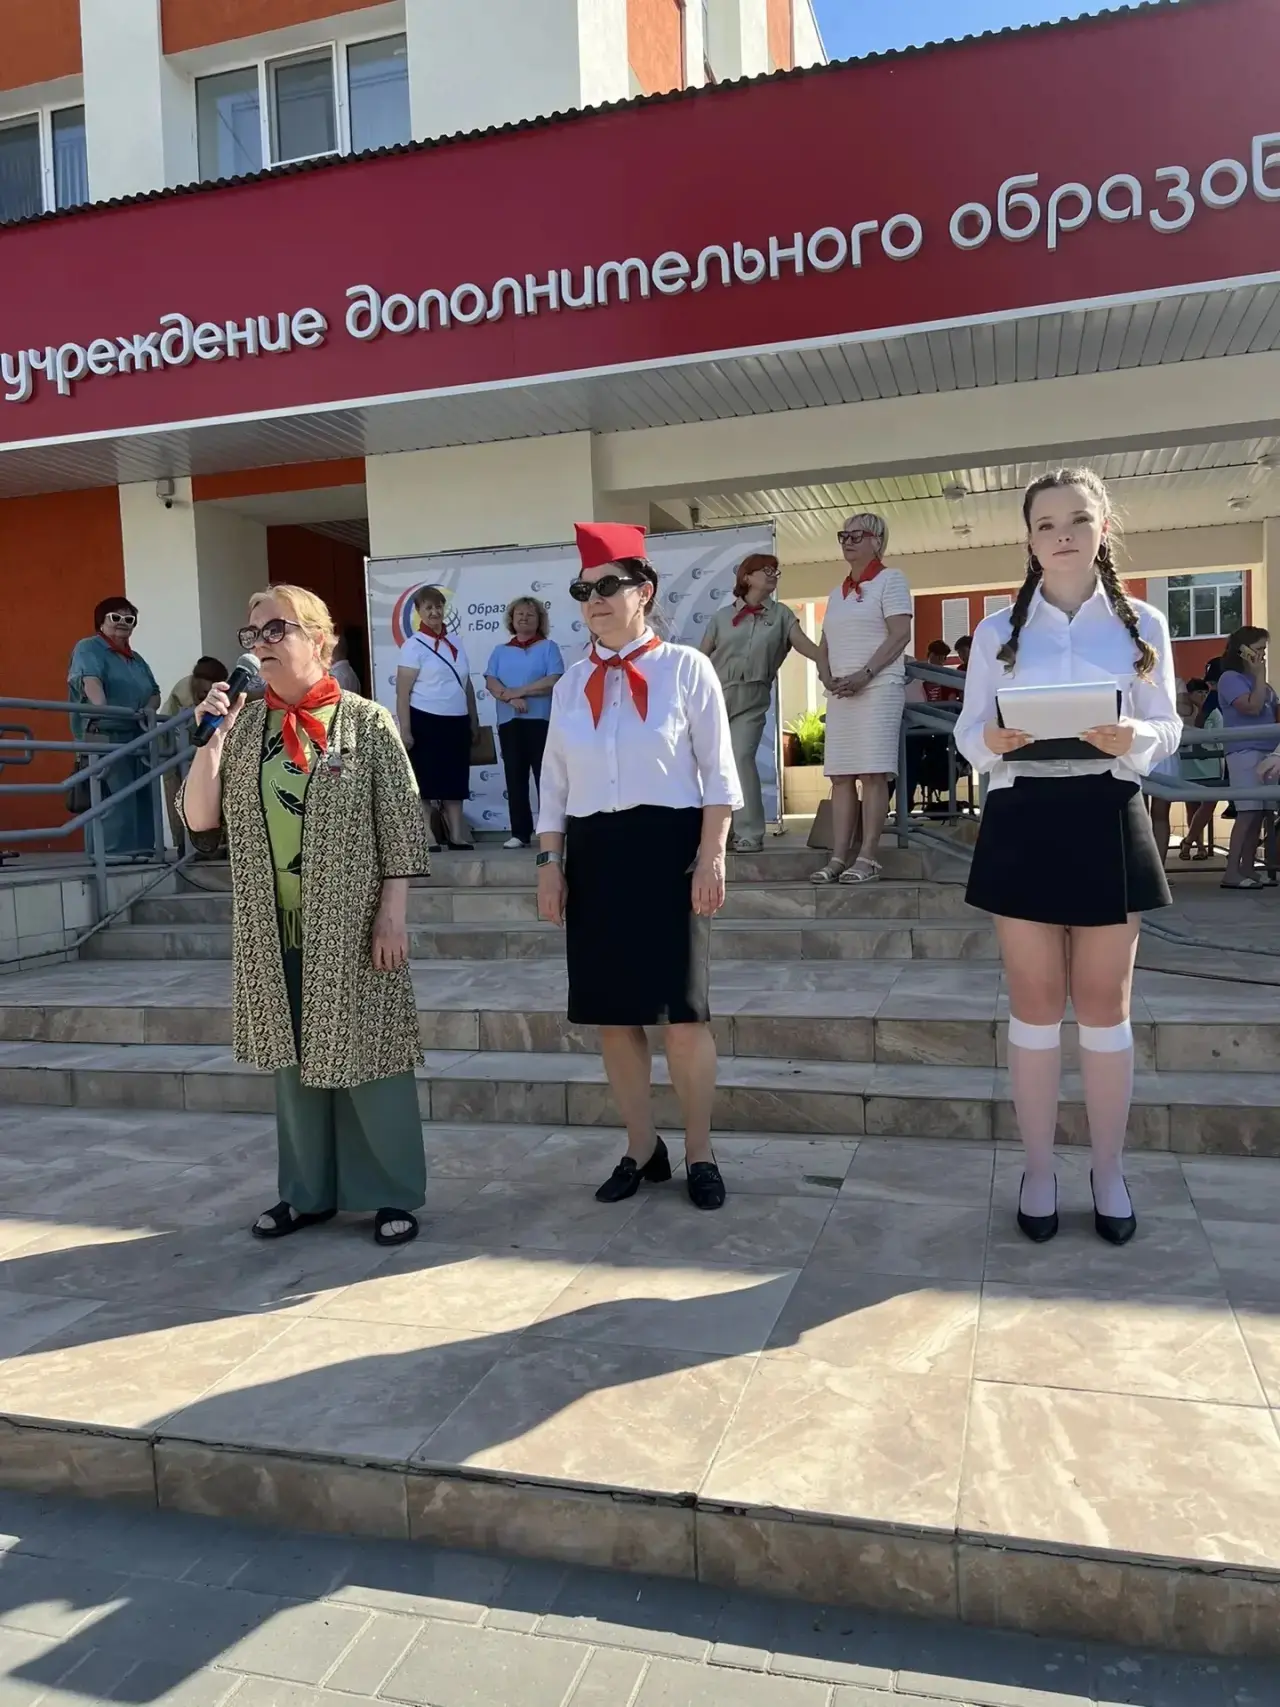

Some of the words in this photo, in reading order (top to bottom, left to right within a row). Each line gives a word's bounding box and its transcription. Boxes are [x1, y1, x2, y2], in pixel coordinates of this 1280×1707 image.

[1, 306, 328, 401] учреждение
[345, 212, 924, 341] дополнительного
[467, 600, 552, 616] Образе
